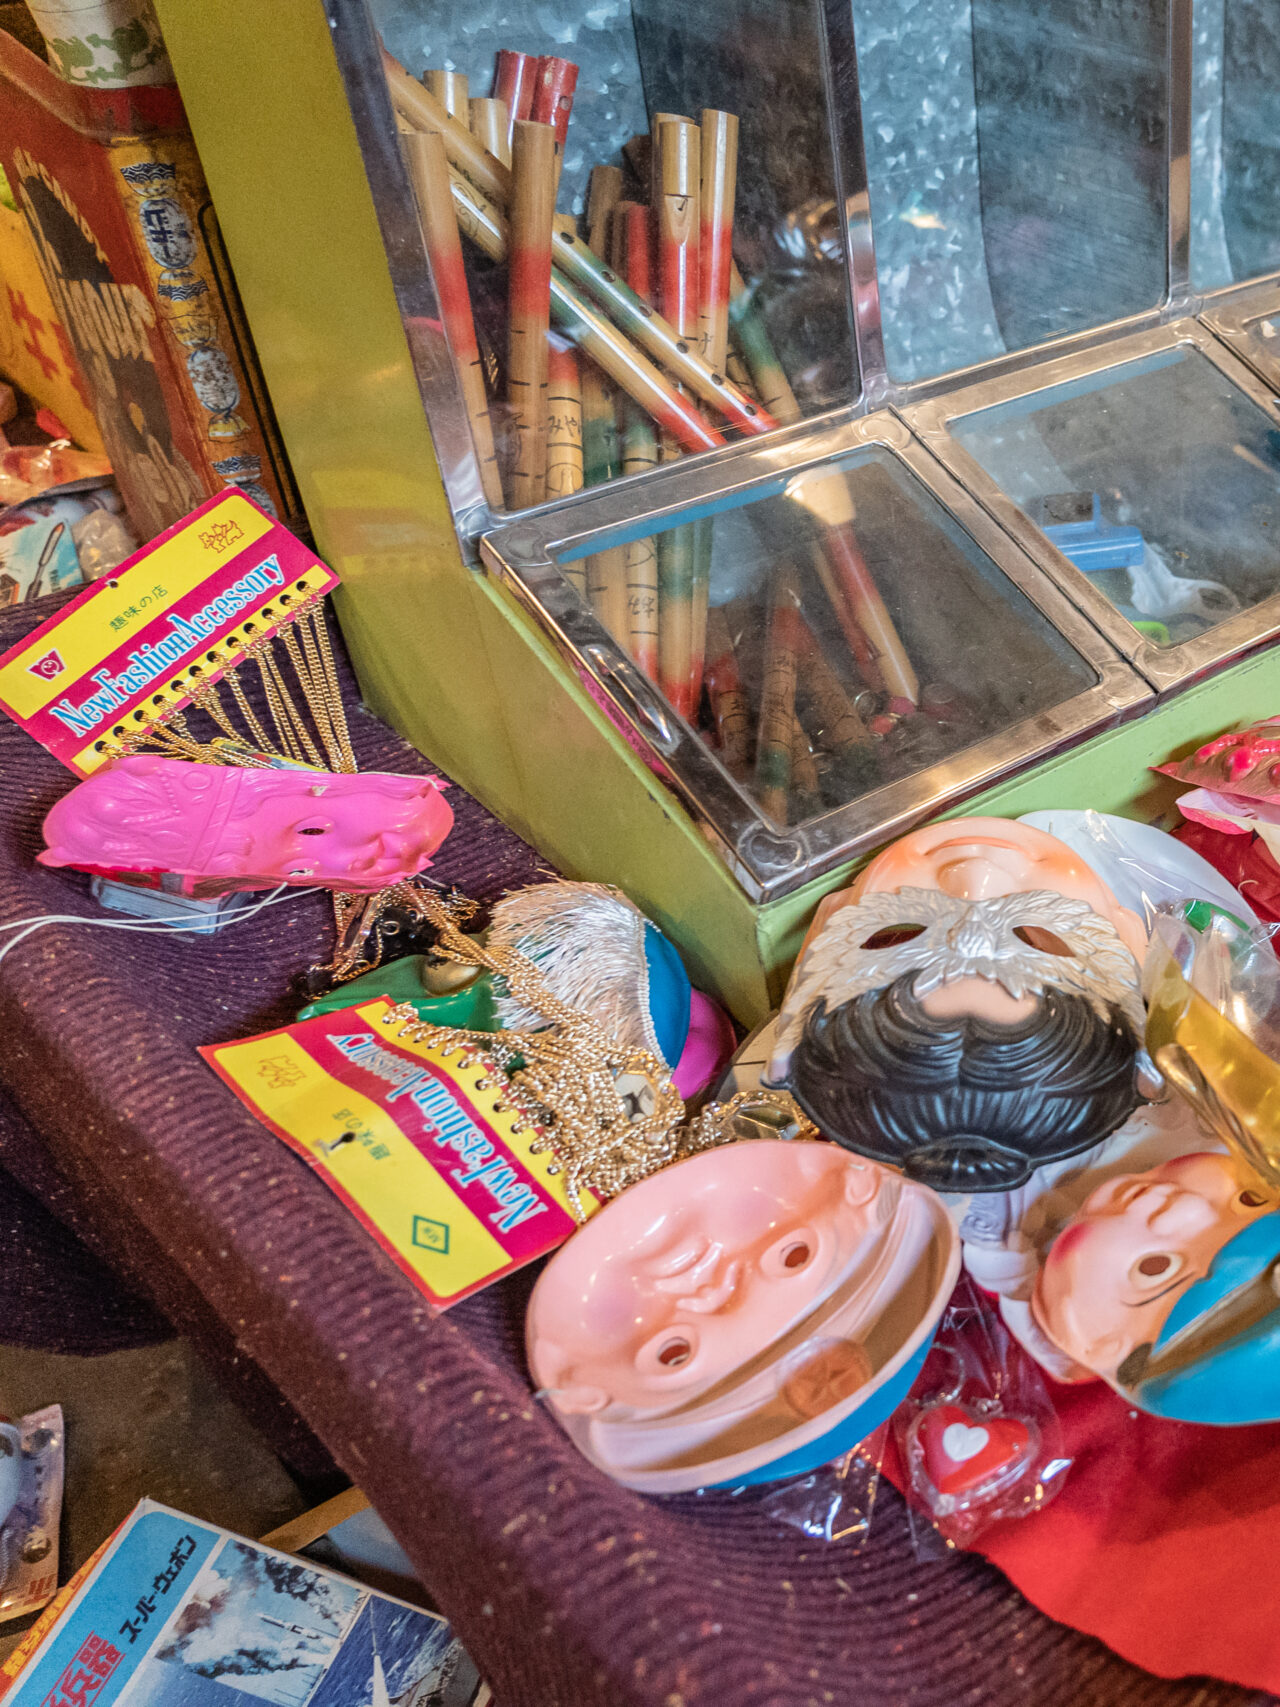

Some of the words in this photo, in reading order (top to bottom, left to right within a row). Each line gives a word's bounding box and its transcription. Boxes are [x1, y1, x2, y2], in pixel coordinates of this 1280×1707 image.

[109, 584, 168, 632] 趣味の店
[49, 1633, 122, 1707] 兵器
